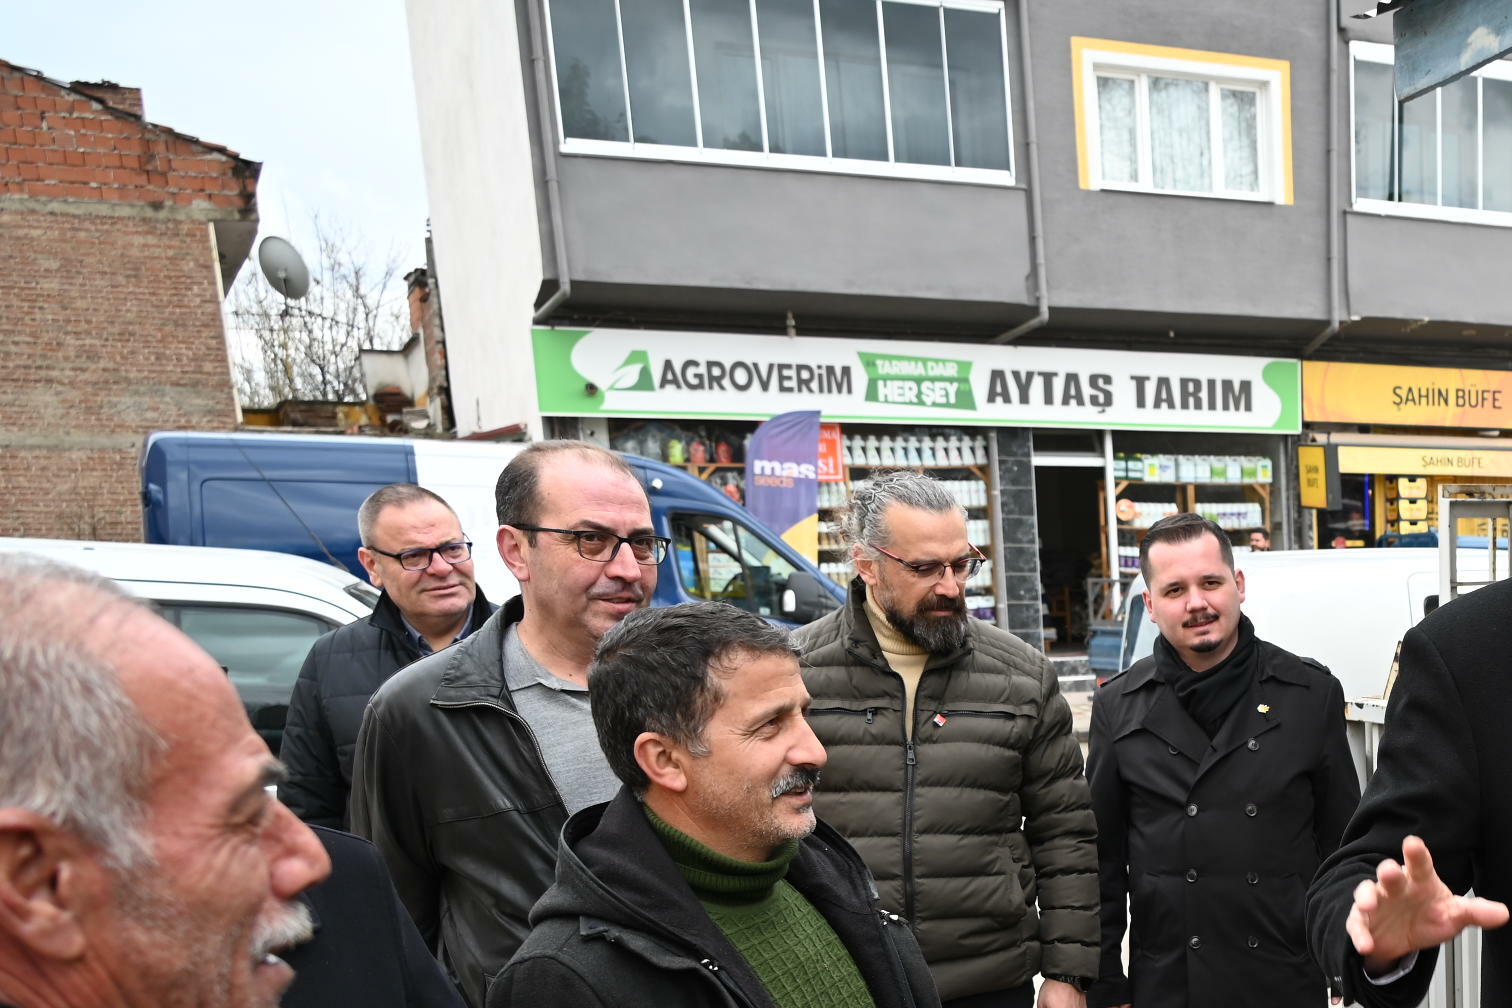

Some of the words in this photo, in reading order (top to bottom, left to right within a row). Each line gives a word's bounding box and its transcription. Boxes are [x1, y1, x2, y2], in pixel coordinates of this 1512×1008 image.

[876, 359, 926, 376] TARIMA
[878, 380, 919, 403] HER
[921, 381, 959, 406] ŞEY
[986, 369, 1113, 414] AYTAŞ
[1130, 375, 1253, 413] TARIM
[1392, 382, 1449, 411] ŞAHİN
[1455, 384, 1503, 409] BÜFE
[753, 459, 816, 479] mas
